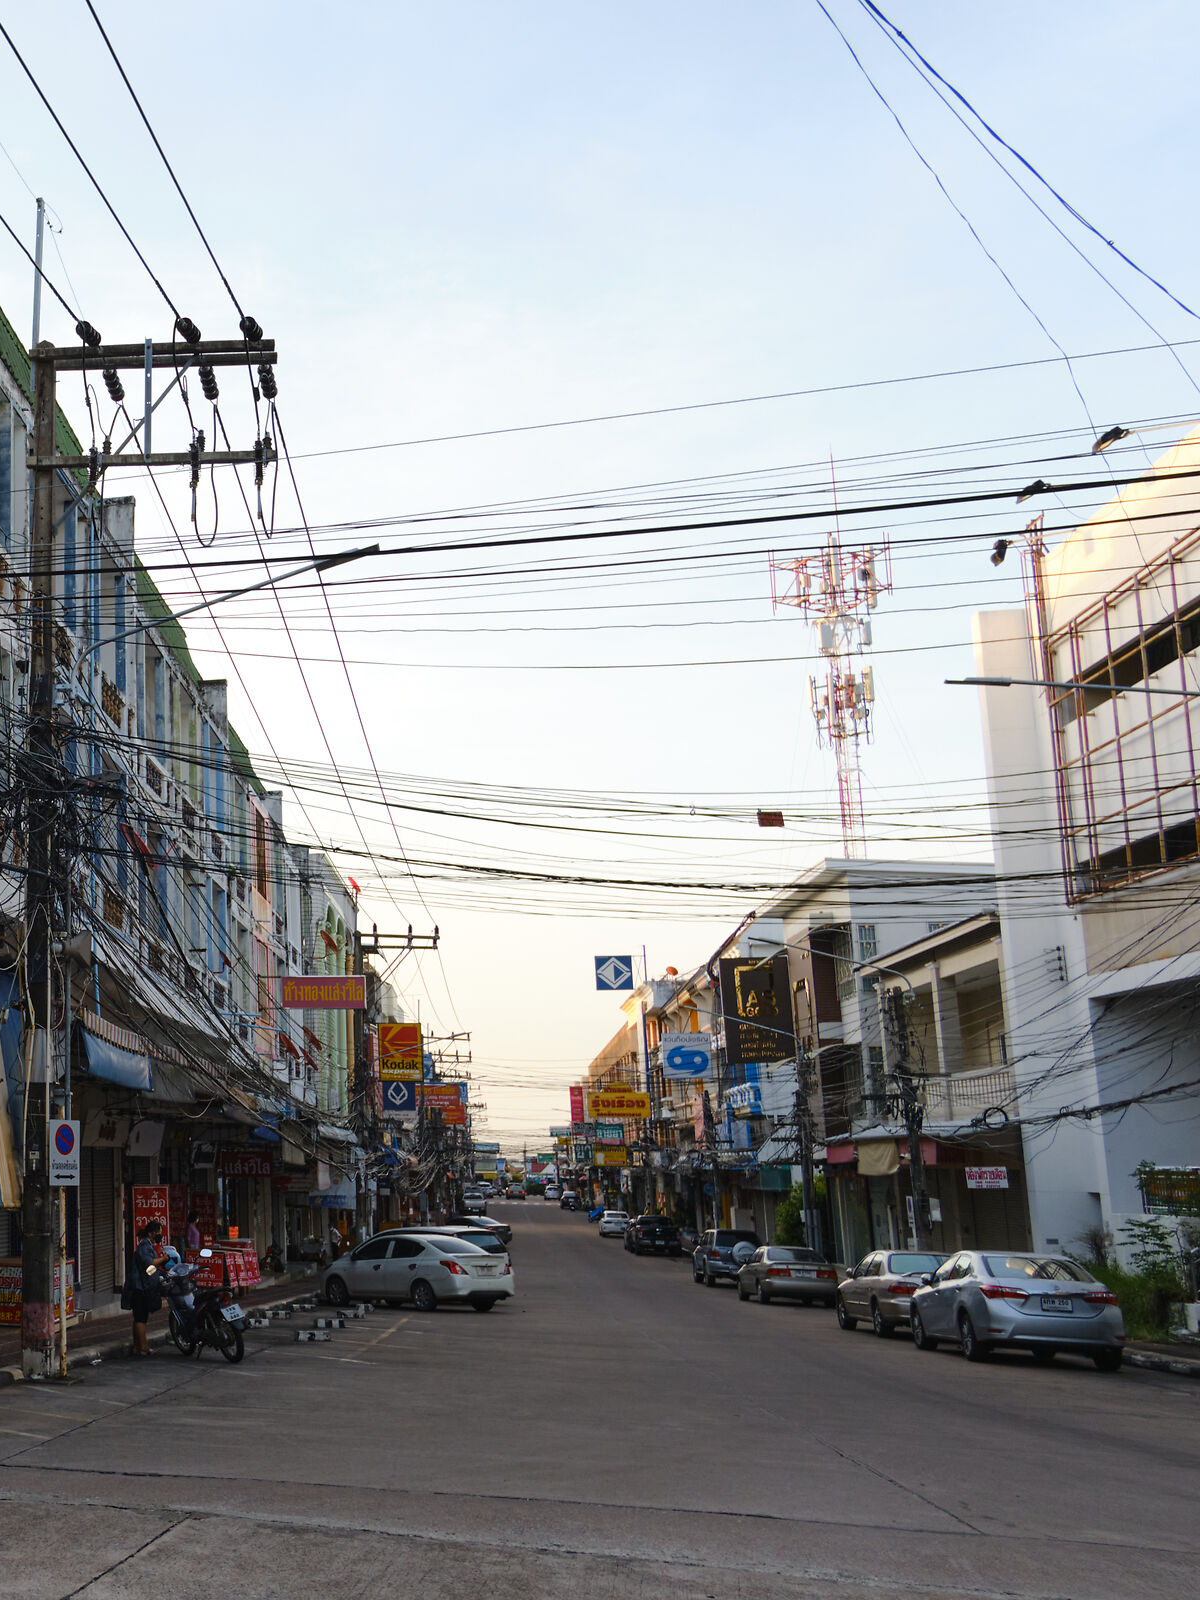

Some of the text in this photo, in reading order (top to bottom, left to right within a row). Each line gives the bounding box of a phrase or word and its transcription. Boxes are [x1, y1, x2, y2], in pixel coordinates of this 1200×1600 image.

[283, 979, 364, 1002] ห้างทองแสงวิไล
[382, 1059, 418, 1070] Kodak
[591, 1095, 646, 1112] รุ่งเรือง
[135, 1190, 166, 1208] รับซื้อ
